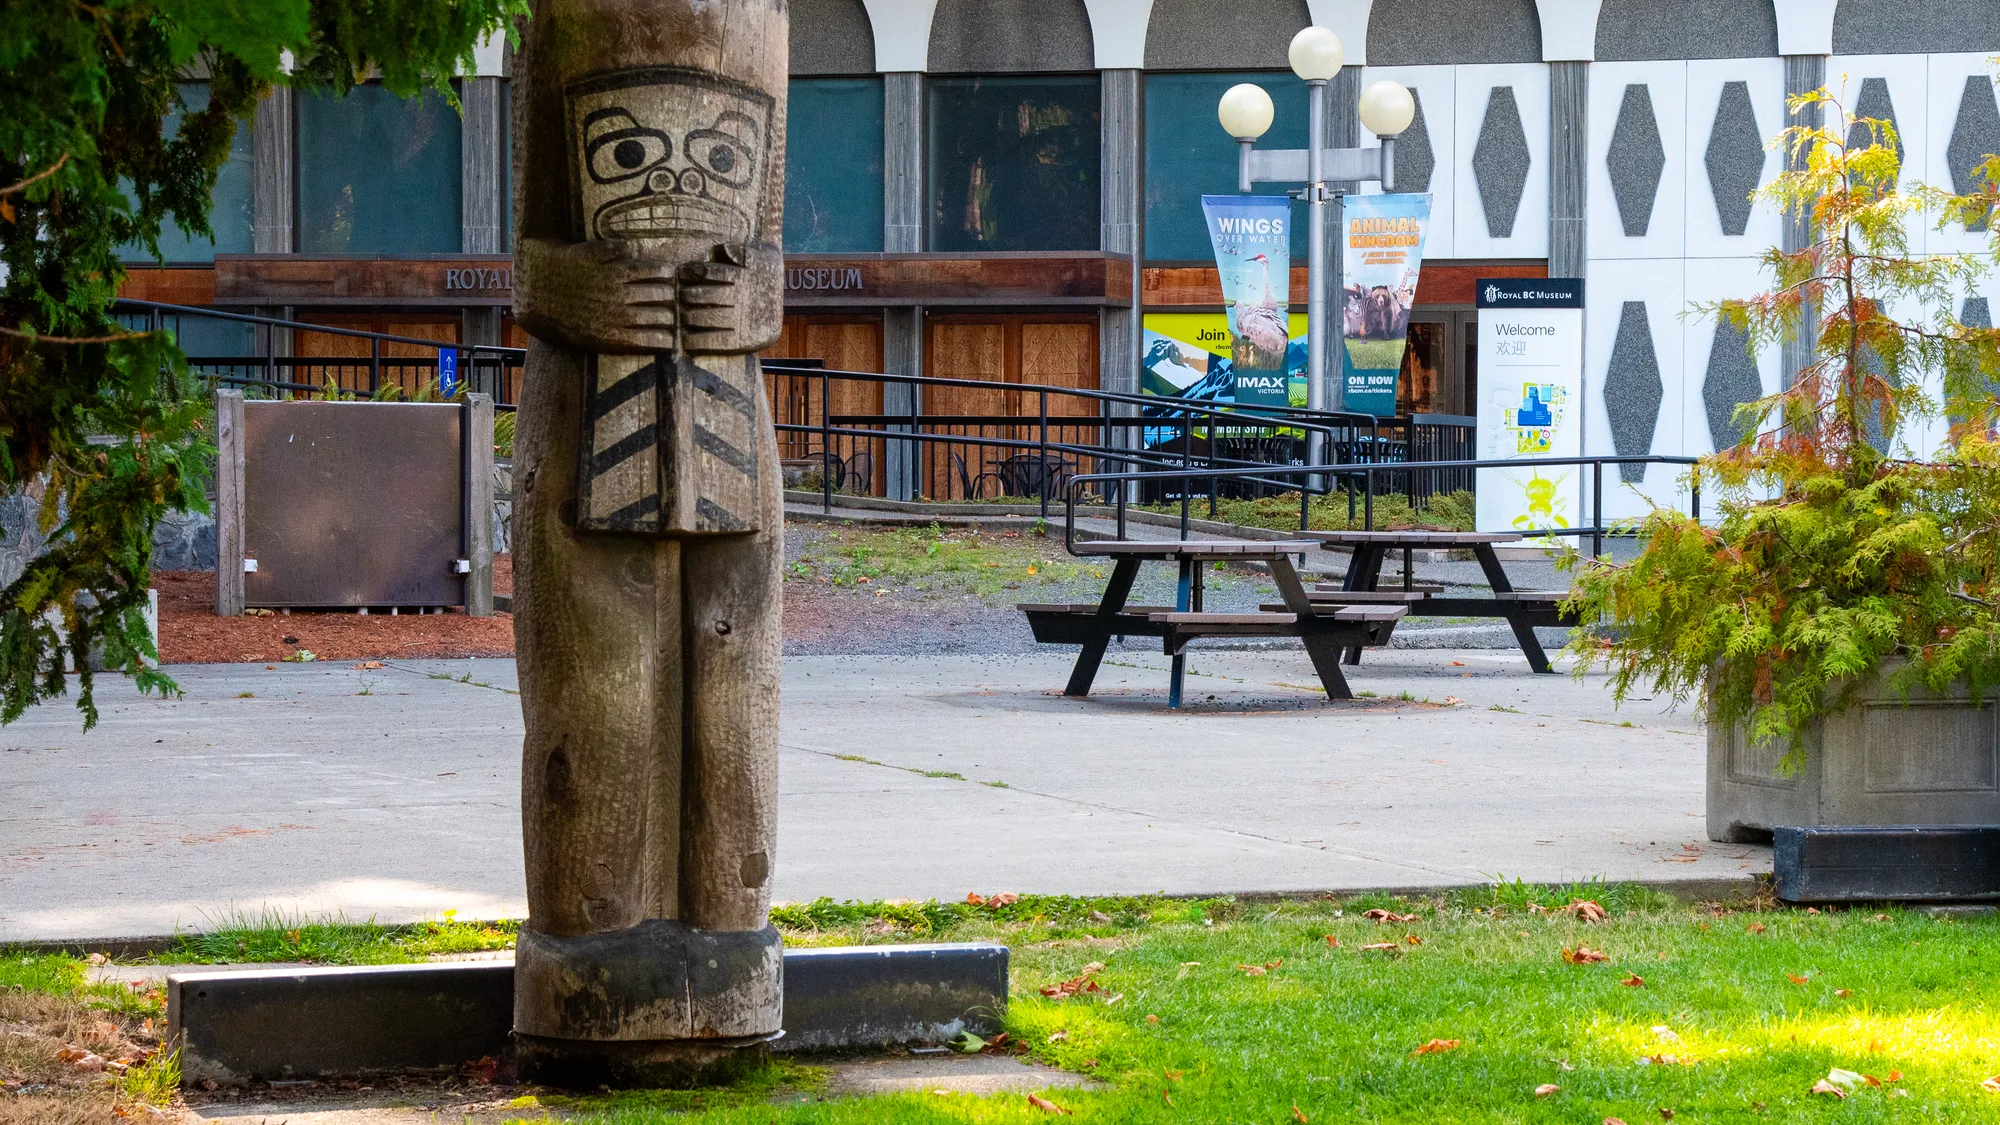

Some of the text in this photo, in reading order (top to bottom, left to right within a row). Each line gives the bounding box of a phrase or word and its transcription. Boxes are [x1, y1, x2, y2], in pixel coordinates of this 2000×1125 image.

[1217, 217, 1284, 235] WINGS
[1349, 216, 1420, 234] ANIMAL
[1216, 233, 1286, 245] OVER WATER
[1349, 233, 1420, 249] KINGDOM
[1523, 291, 1535, 299] BC
[1196, 328, 1226, 341] Join
[1495, 323, 1556, 336] Welcome
[1495, 340, 1526, 356] 欢迎
[1237, 377, 1284, 388] IMAX
[1348, 376, 1393, 385] ON NOW
